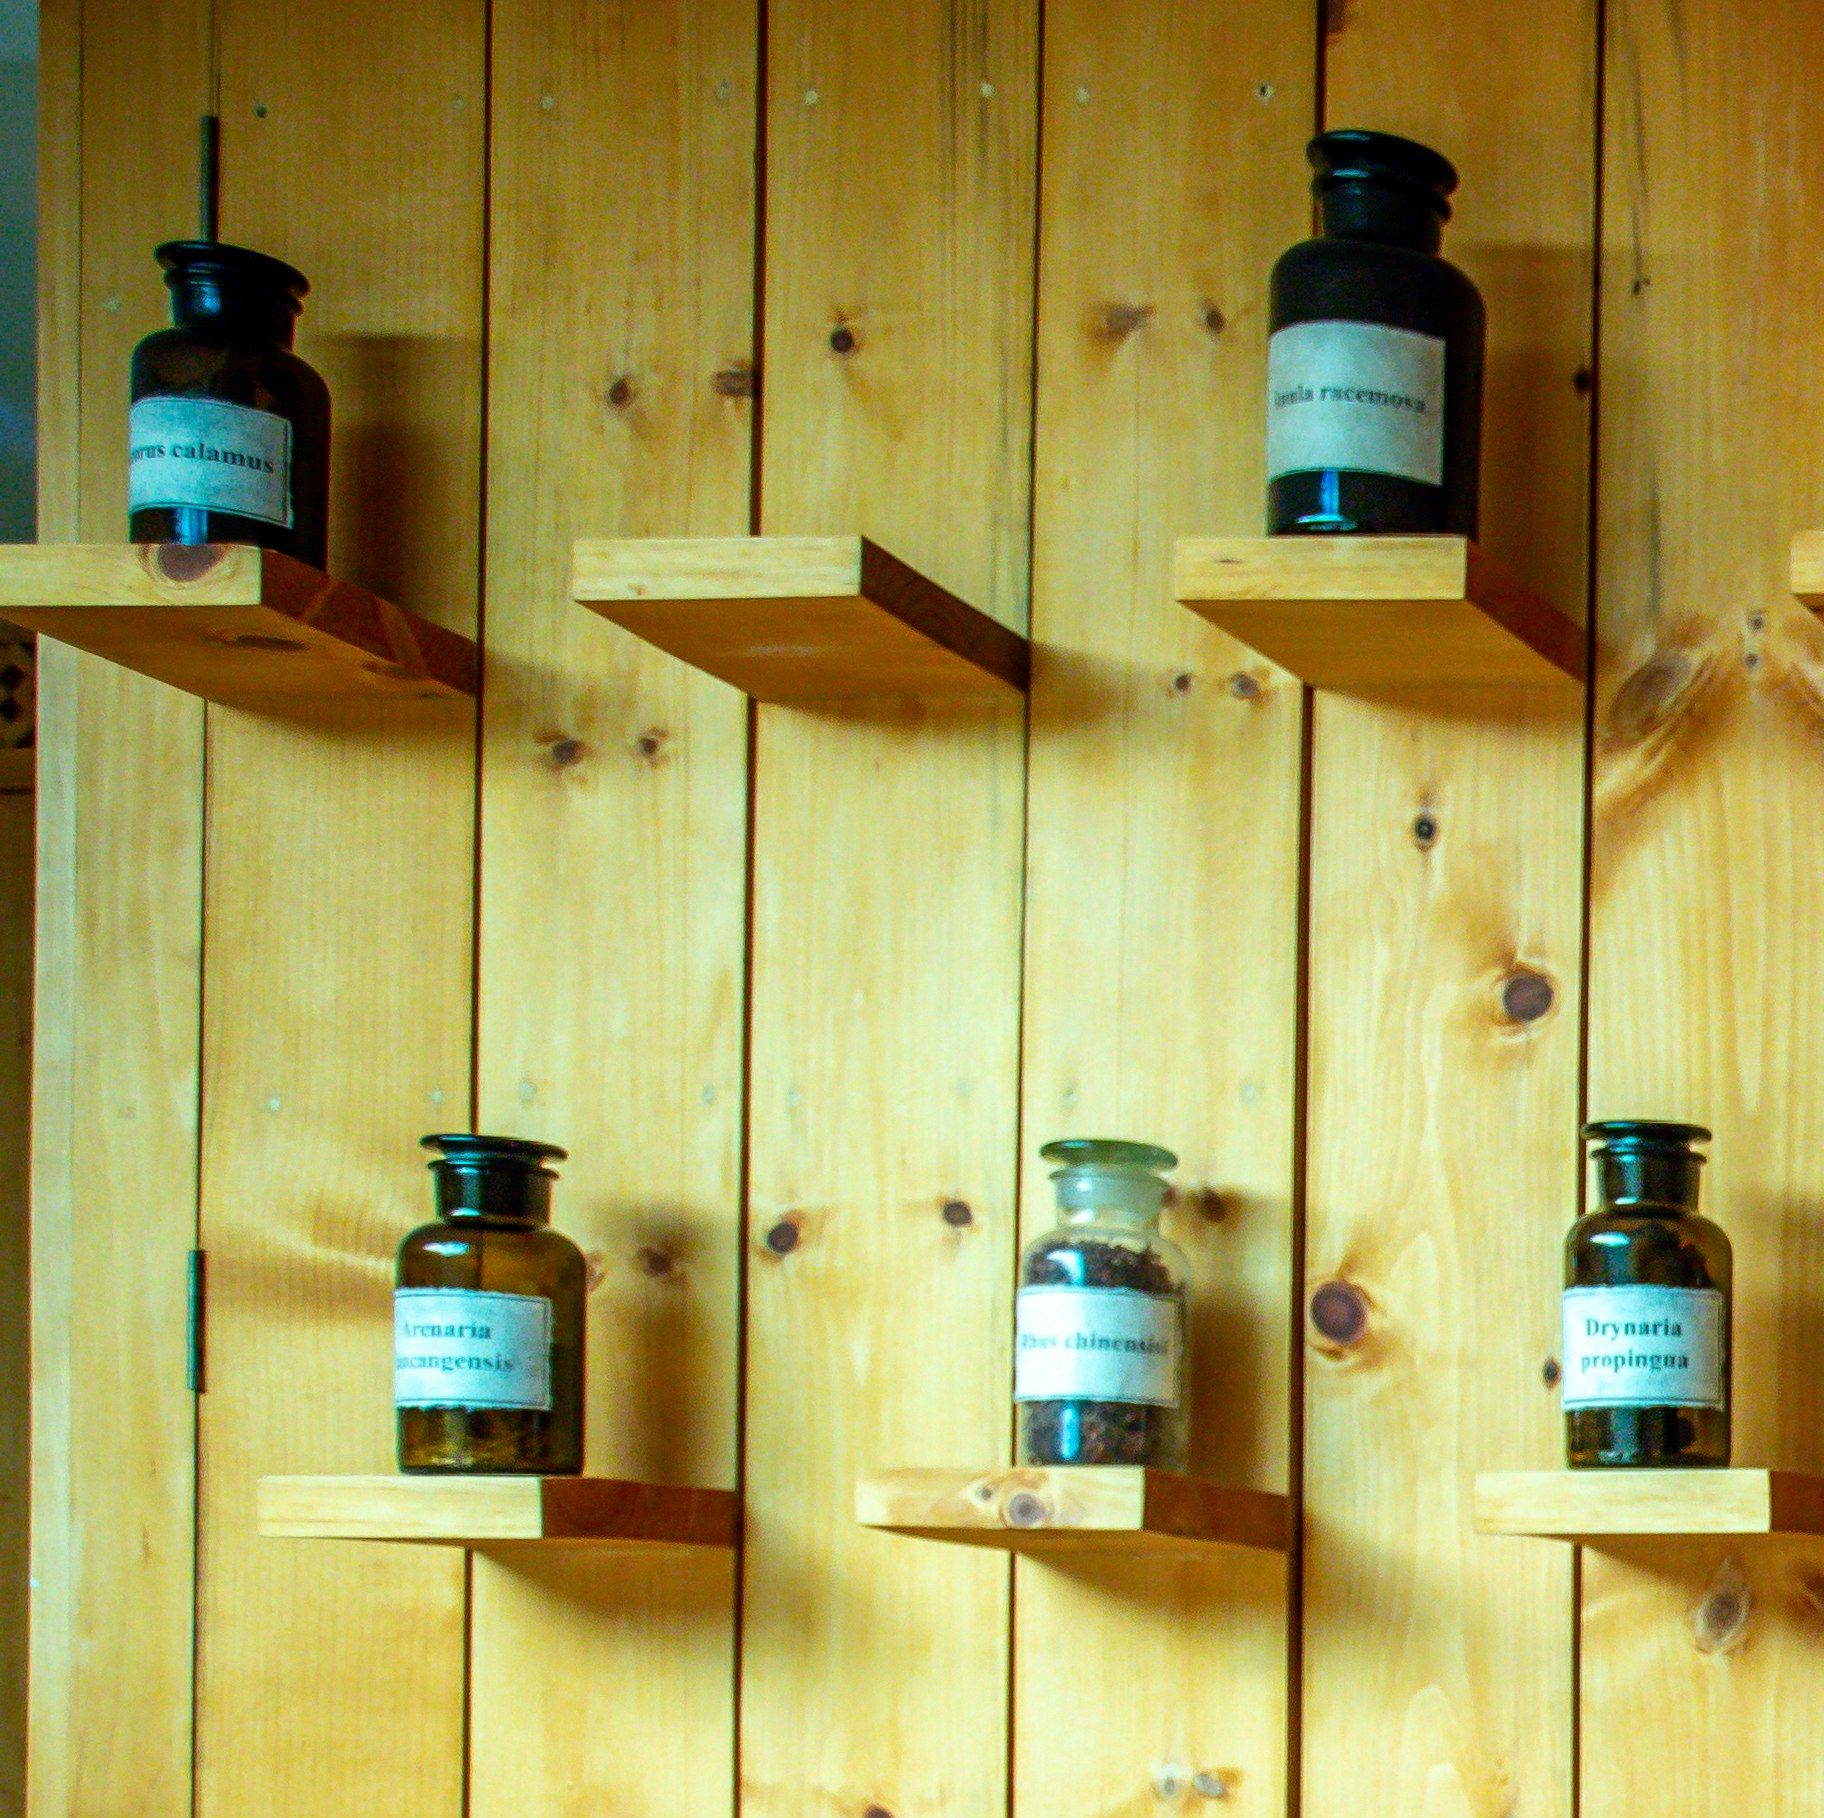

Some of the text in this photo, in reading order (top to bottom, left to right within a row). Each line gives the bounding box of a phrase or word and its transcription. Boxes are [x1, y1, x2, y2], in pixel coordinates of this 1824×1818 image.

[1320, 387, 1426, 414] racemosa
[173, 442, 274, 474] calamus
[1585, 1317, 1682, 1340] Drynaria
